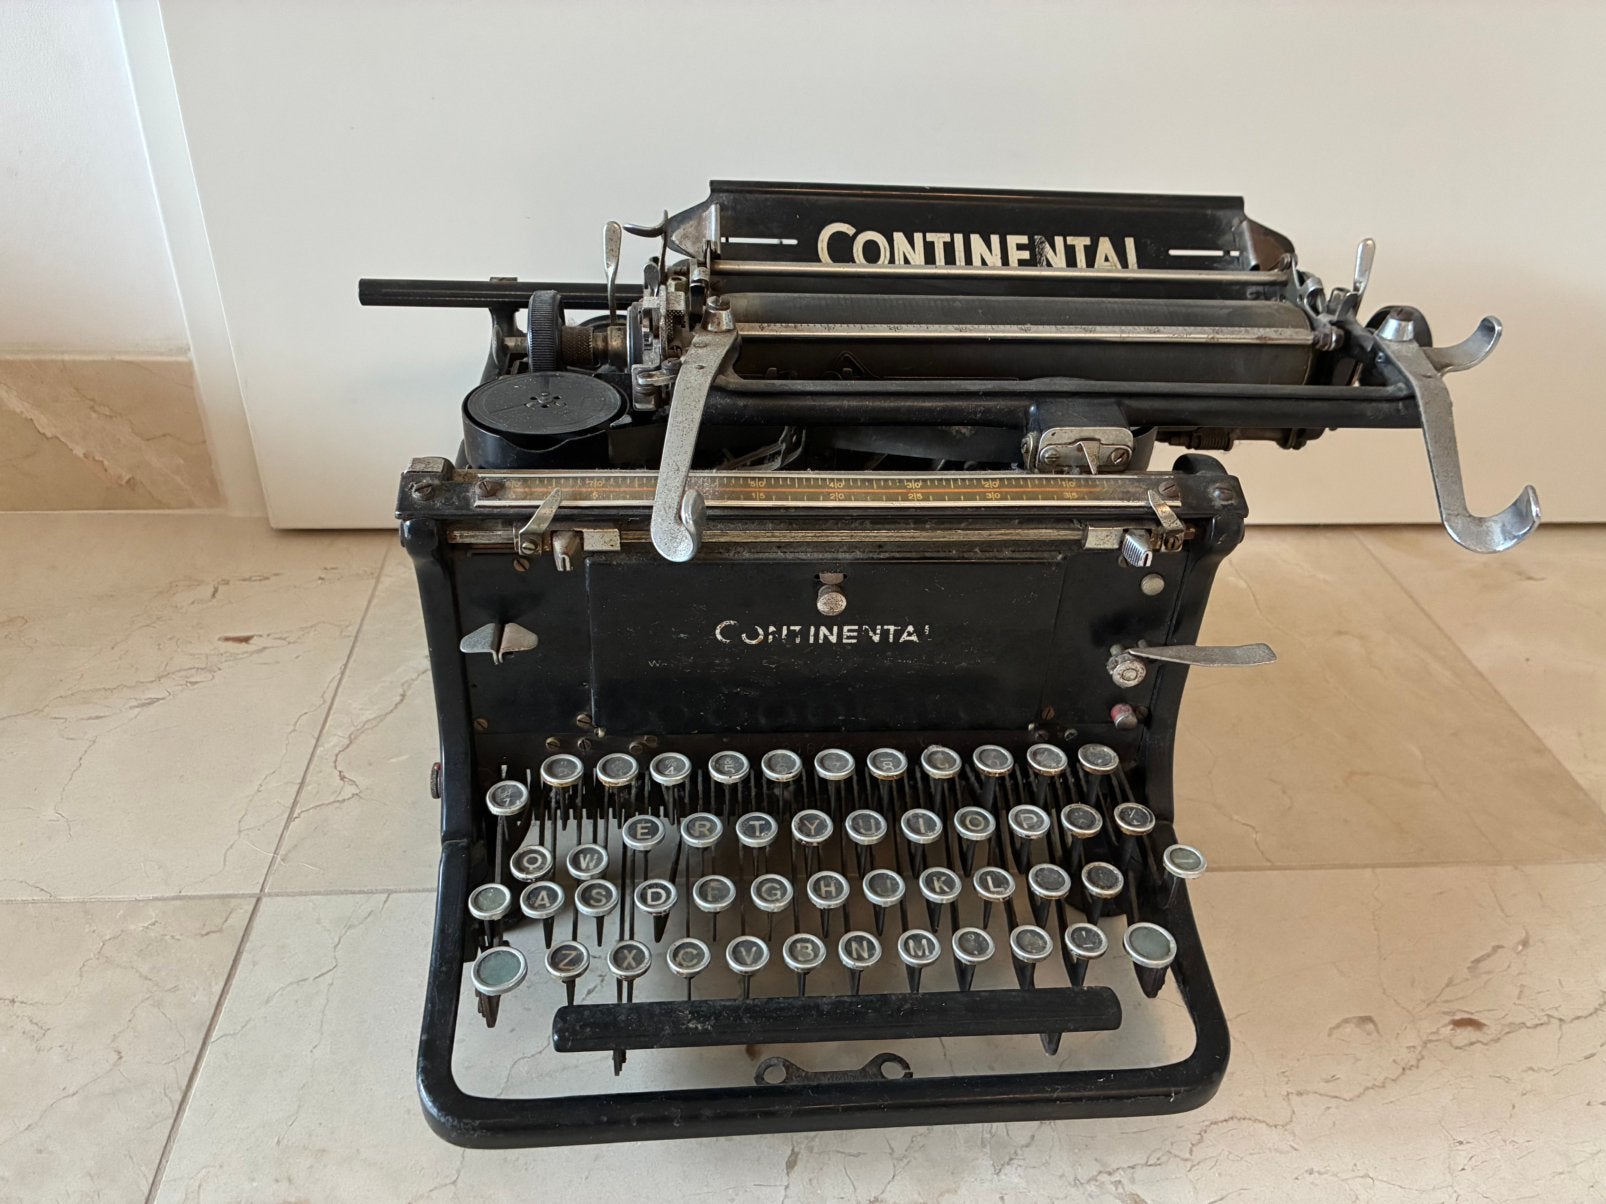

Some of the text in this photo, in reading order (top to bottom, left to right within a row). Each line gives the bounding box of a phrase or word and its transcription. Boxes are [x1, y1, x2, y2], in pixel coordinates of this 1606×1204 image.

[714, 619, 933, 645] CONTINENTA
[724, 765, 735, 774] 5
[523, 854, 542, 870] Q
[580, 854, 599, 869] W
[636, 823, 652, 839] E
[694, 821, 711, 836] R
[749, 821, 765, 836] T
[804, 820, 820, 835] Y
[859, 819, 875, 834] U
[966, 816, 984, 830] O
[1020, 814, 1037, 828] P
[534, 890, 551, 907] A
[590, 889, 606, 906] S
[646, 888, 666, 905] D
[707, 882, 721, 901] F
[761, 883, 781, 900] G
[820, 880, 836, 897] H
[933, 876, 950, 893] K
[986, 875, 1005, 892] L
[557, 950, 577, 969] Z
[623, 949, 637, 968] X
[678, 948, 698, 966] C
[740, 947, 757, 965] V
[796, 943, 813, 961] B
[851, 940, 868, 959] N
[908, 939, 930, 956] M
